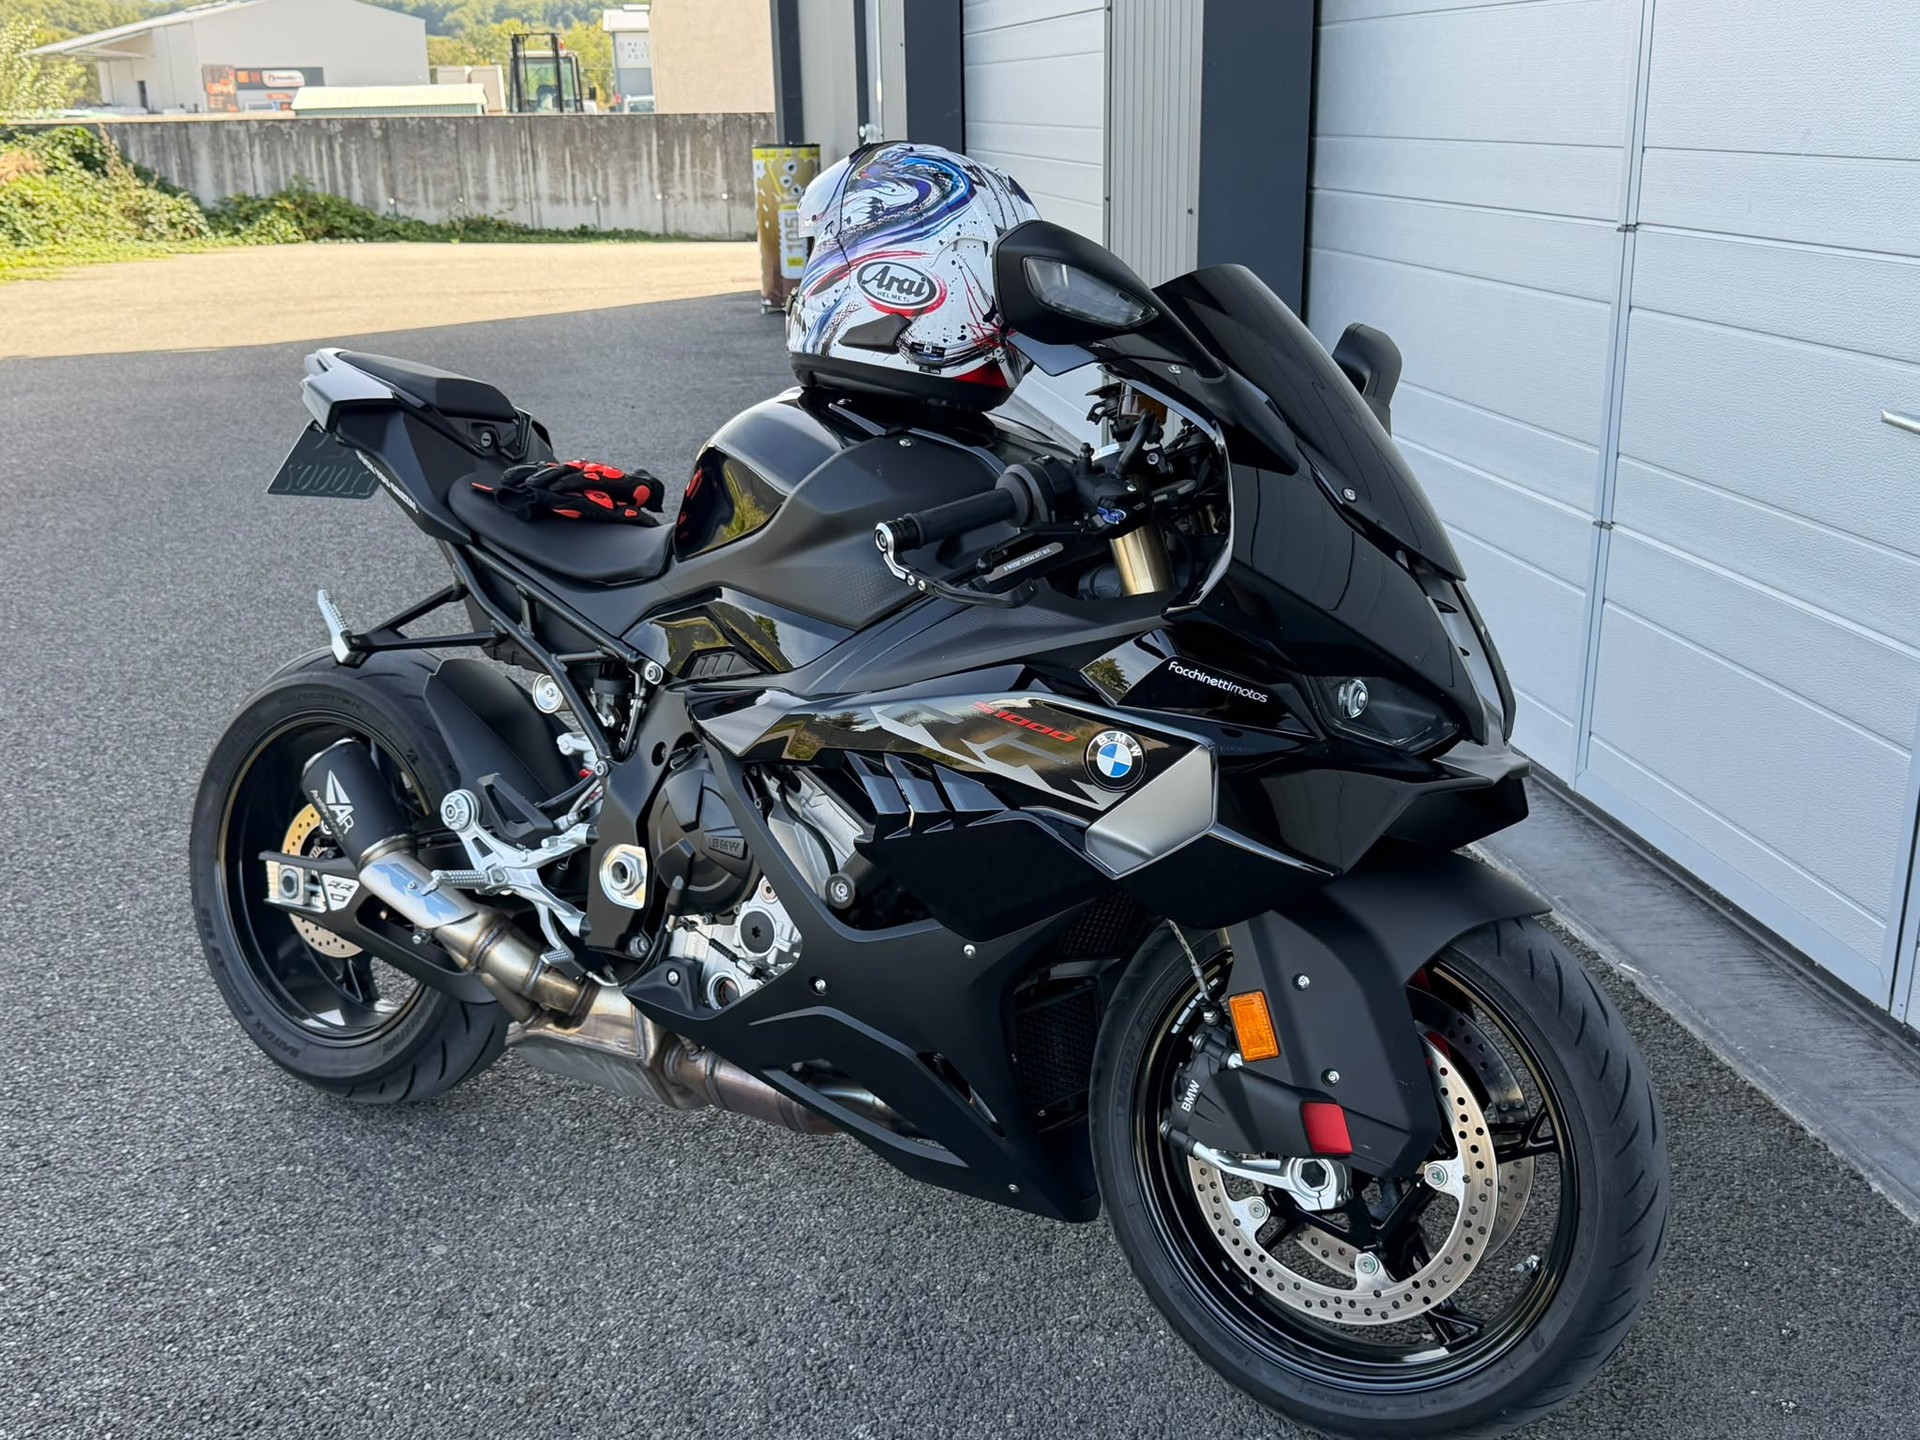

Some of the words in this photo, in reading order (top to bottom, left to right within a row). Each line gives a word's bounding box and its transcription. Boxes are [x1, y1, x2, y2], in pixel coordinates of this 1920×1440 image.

[861, 265, 927, 298] Arai
[1096, 732, 1143, 758] BMW
[711, 838, 740, 852] BMW
[1181, 1079, 1201, 1113] BMW
